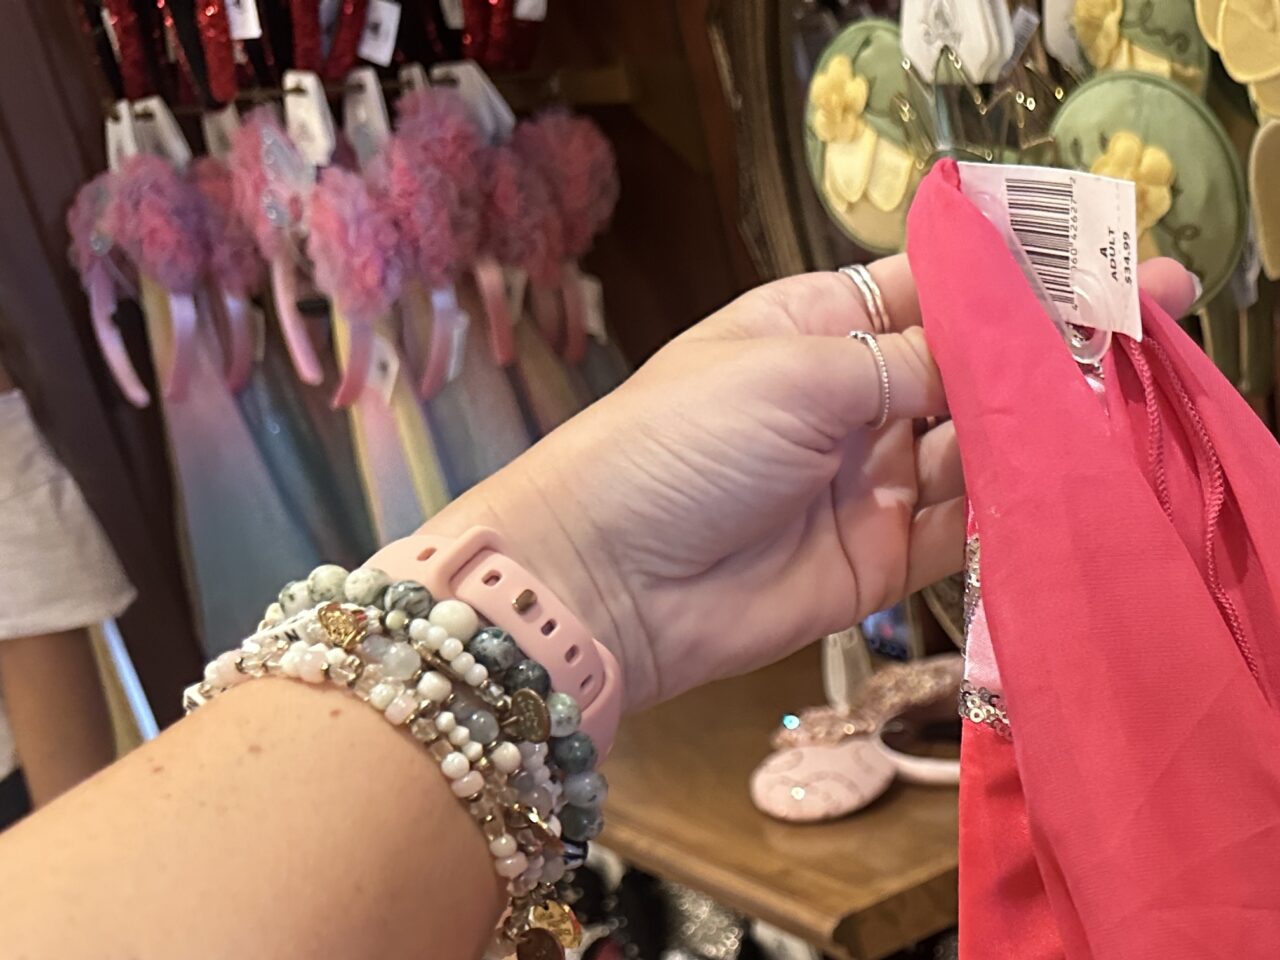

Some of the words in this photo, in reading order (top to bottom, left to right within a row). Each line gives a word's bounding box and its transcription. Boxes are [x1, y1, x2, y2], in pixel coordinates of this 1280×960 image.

[1099, 247, 1108, 258] A
[1107, 226, 1118, 282] ADULT
[1122, 231, 1133, 286] $34.99
